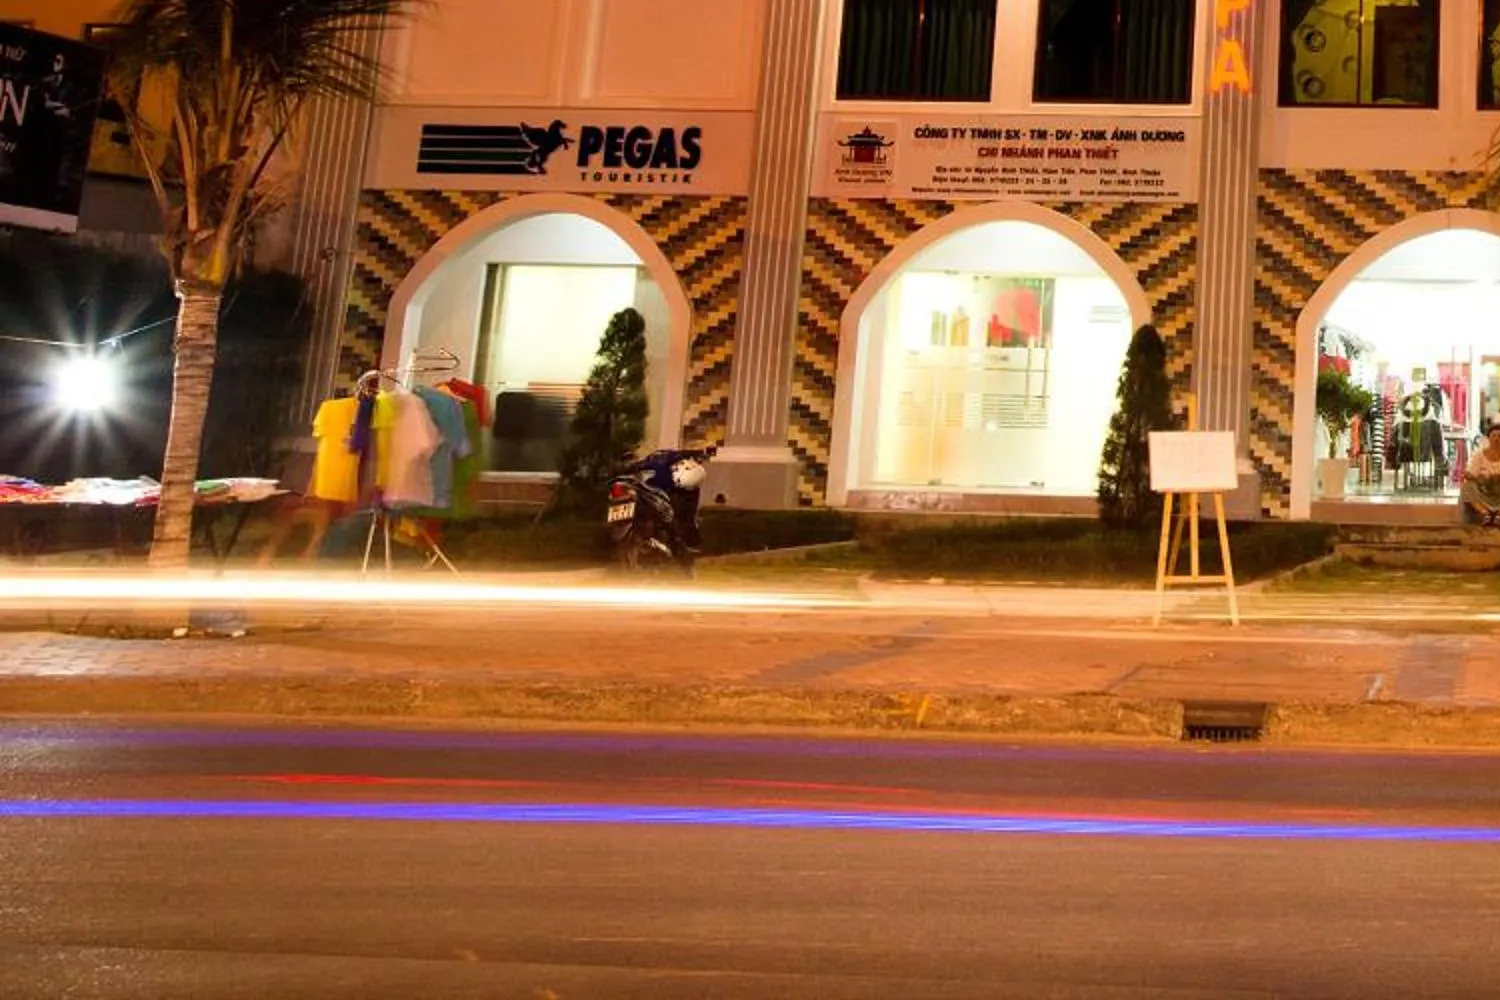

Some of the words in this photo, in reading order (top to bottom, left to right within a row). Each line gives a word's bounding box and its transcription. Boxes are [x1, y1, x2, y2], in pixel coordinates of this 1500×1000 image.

[951, 128, 967, 139] TY
[1029, 129, 1048, 140] TM
[1056, 129, 1072, 140] DV
[577, 125, 702, 169] PEGAS
[1047, 147, 1081, 159] PHAN
[581, 171, 692, 184] TOURISTIK
